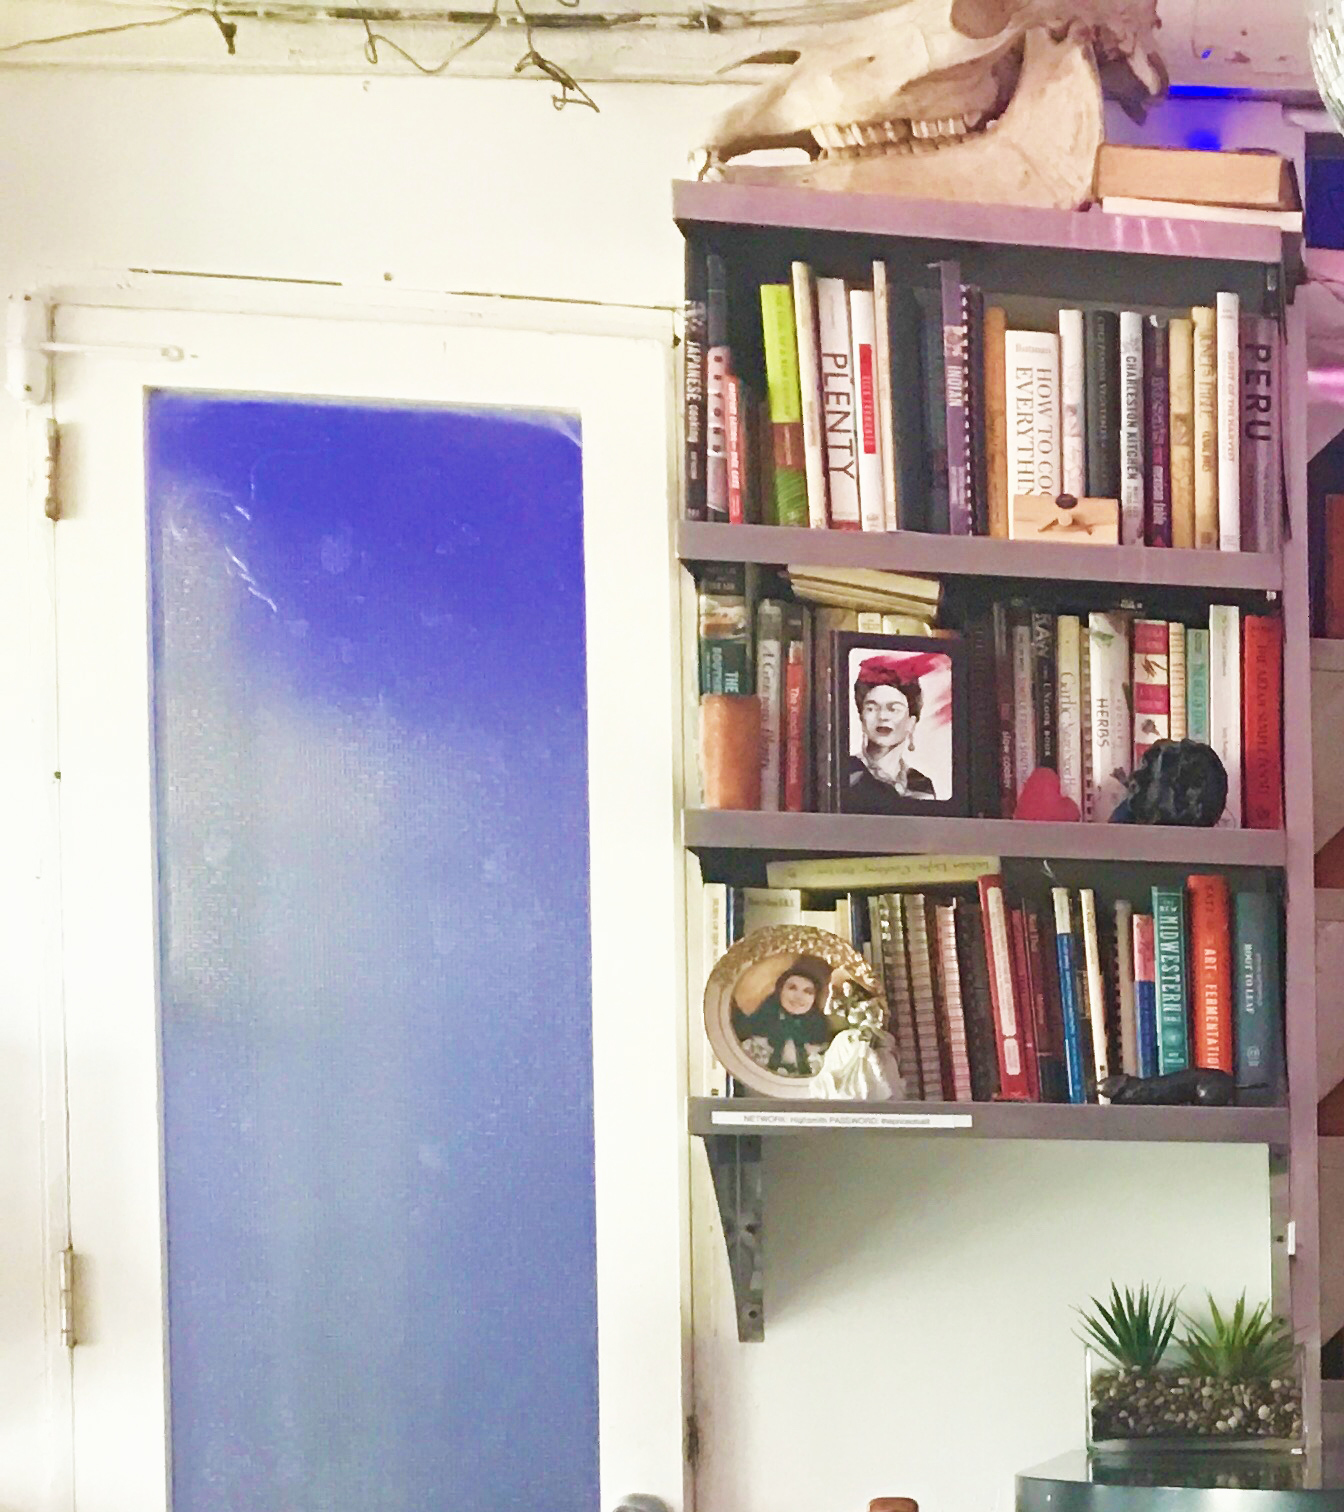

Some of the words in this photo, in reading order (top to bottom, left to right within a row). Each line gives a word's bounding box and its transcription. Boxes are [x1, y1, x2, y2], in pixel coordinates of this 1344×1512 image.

[686, 340, 702, 401] JAPANESE
[947, 364, 962, 407] INDIAN
[1036, 367, 1053, 420] HOW
[1125, 355, 1138, 428] CHARLESTON
[1244, 342, 1272, 442] PERU
[822, 352, 855, 480] PLENTY
[1015, 366, 1034, 496] EVERYTHIN
[1037, 425, 1053, 454] TO
[1038, 460, 1054, 496] CO
[1126, 432, 1138, 480] KITCHEN
[725, 671, 739, 693] THE
[1060, 672, 1077, 720] Garlic
[1002, 731, 1011, 754] slow
[1096, 698, 1109, 747] HERBS
[1159, 915, 1182, 1012] MIDWESTERN
[1204, 948, 1217, 971] ART
[1243, 944, 1253, 970] ROOT
[1245, 974, 1253, 987] TO
[1245, 989, 1254, 1014] LEAF
